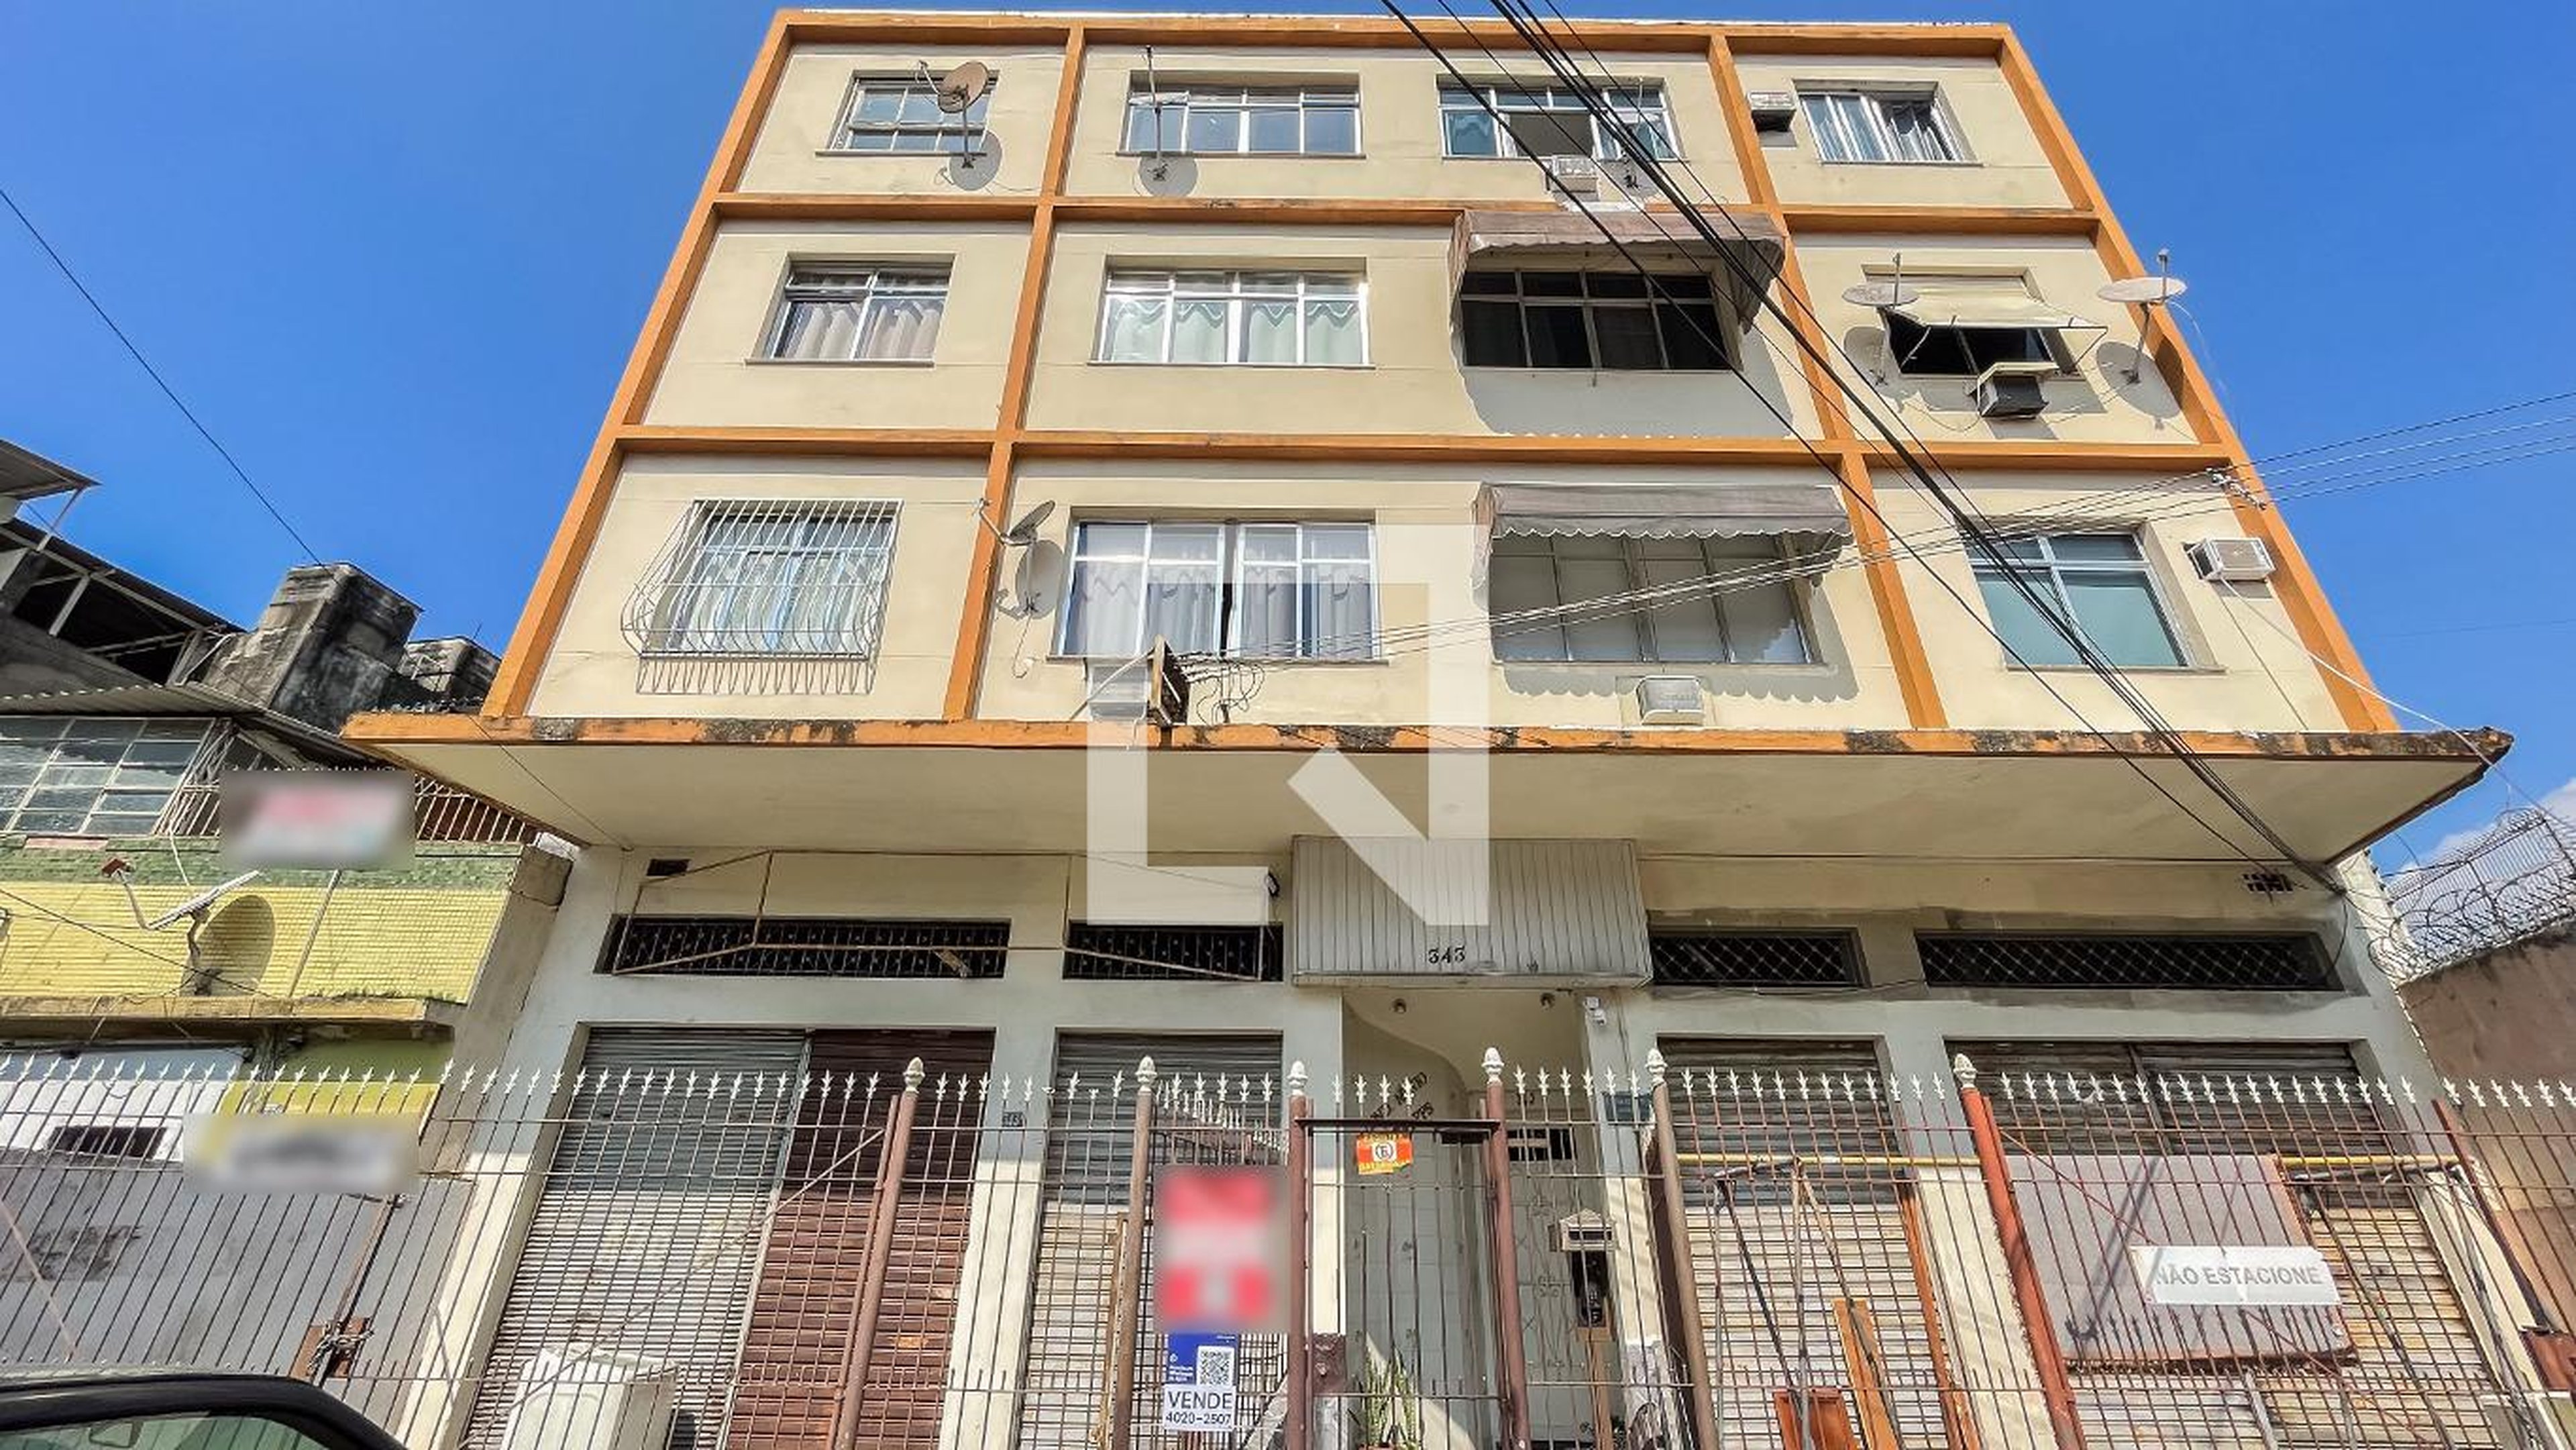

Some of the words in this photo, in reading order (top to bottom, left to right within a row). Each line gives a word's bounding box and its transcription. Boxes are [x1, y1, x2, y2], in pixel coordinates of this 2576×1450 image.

[1428, 945, 1465, 964] 343
[2156, 1263, 2198, 1285] NÃO
[2202, 1266, 2323, 1285] ESTACIONE
[1167, 1391, 1233, 1409] VENDE
[1165, 1411, 1232, 1425] 4020-2507
